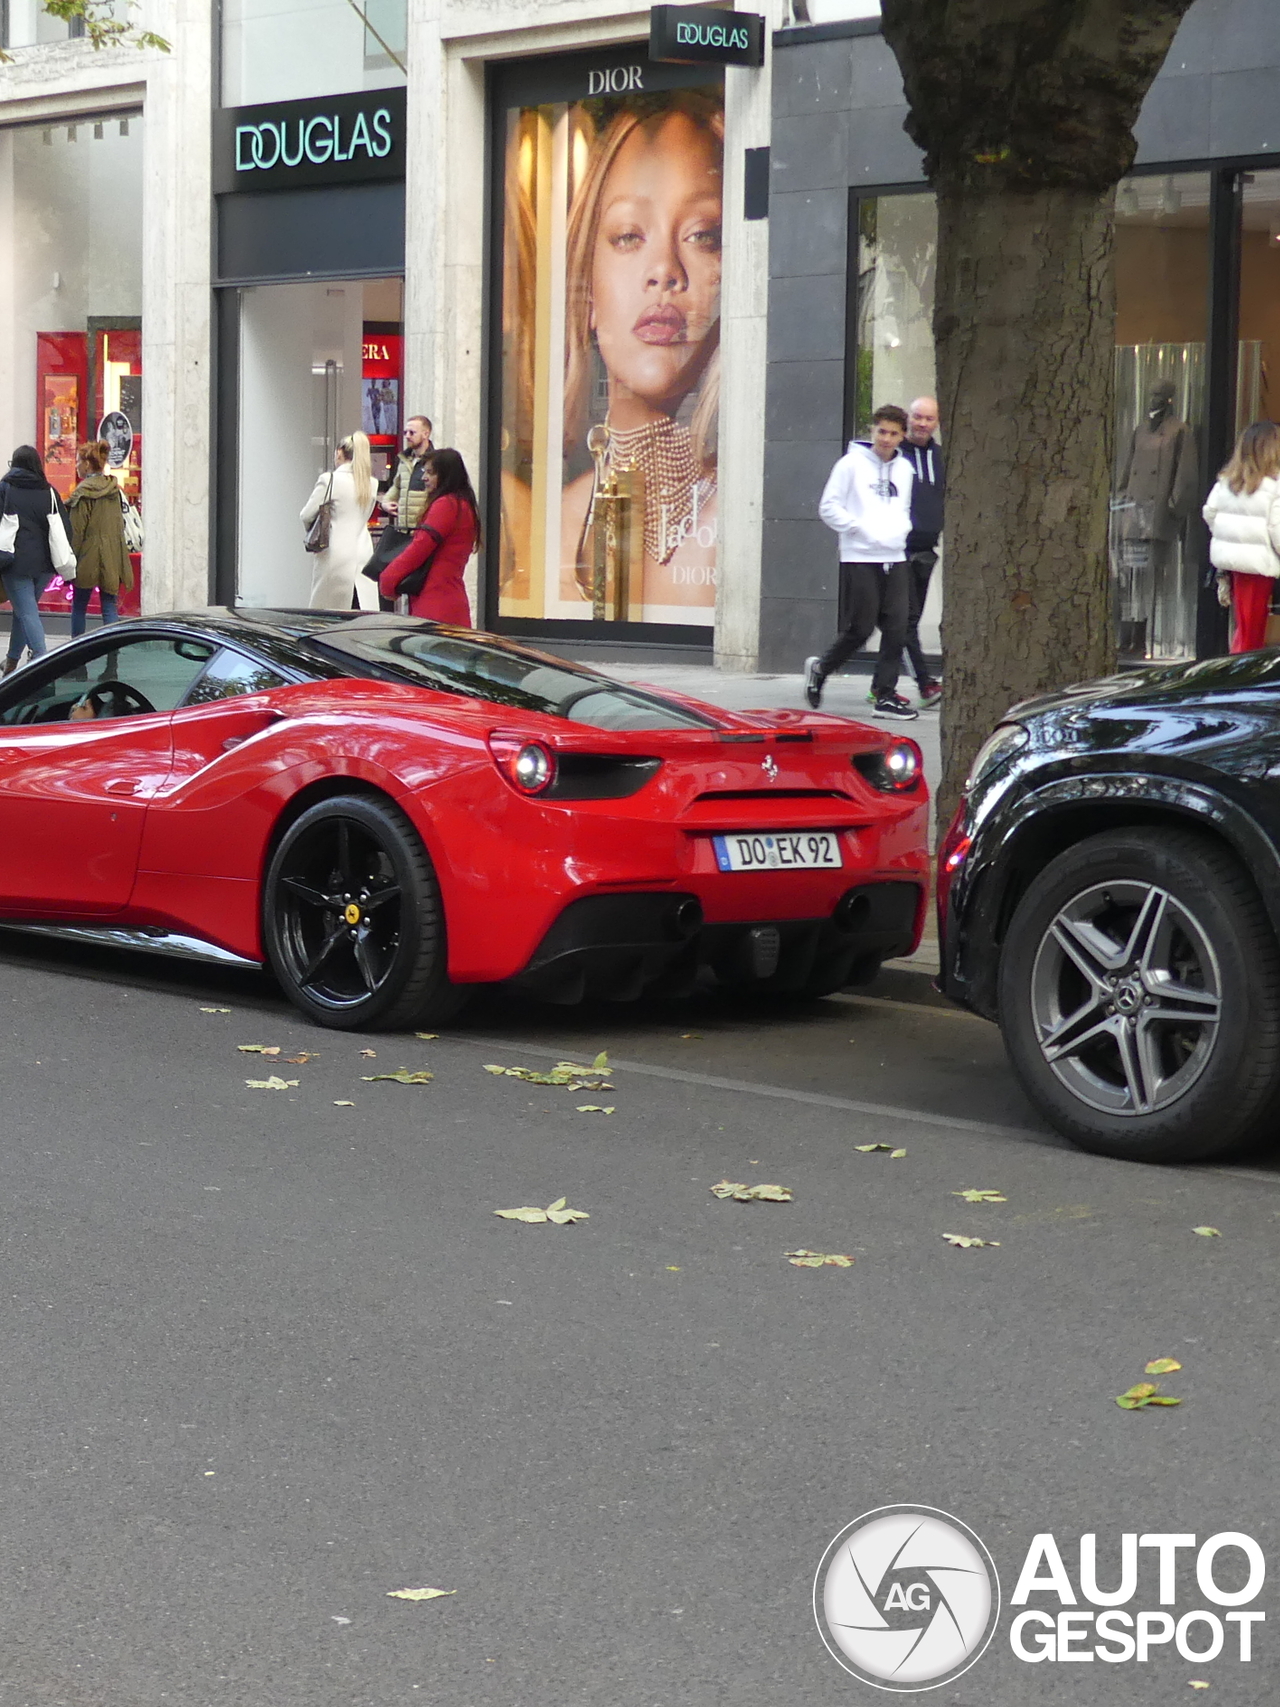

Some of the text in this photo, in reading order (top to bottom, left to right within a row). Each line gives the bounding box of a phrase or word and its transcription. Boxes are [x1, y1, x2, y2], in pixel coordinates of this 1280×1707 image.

[677, 22, 749, 49] DOUGLAS
[588, 65, 644, 95] DIOR
[235, 108, 392, 171] DOUGLAS
[736, 838, 766, 865] DO
[776, 837, 806, 864] EK
[808, 836, 833, 863] 92
